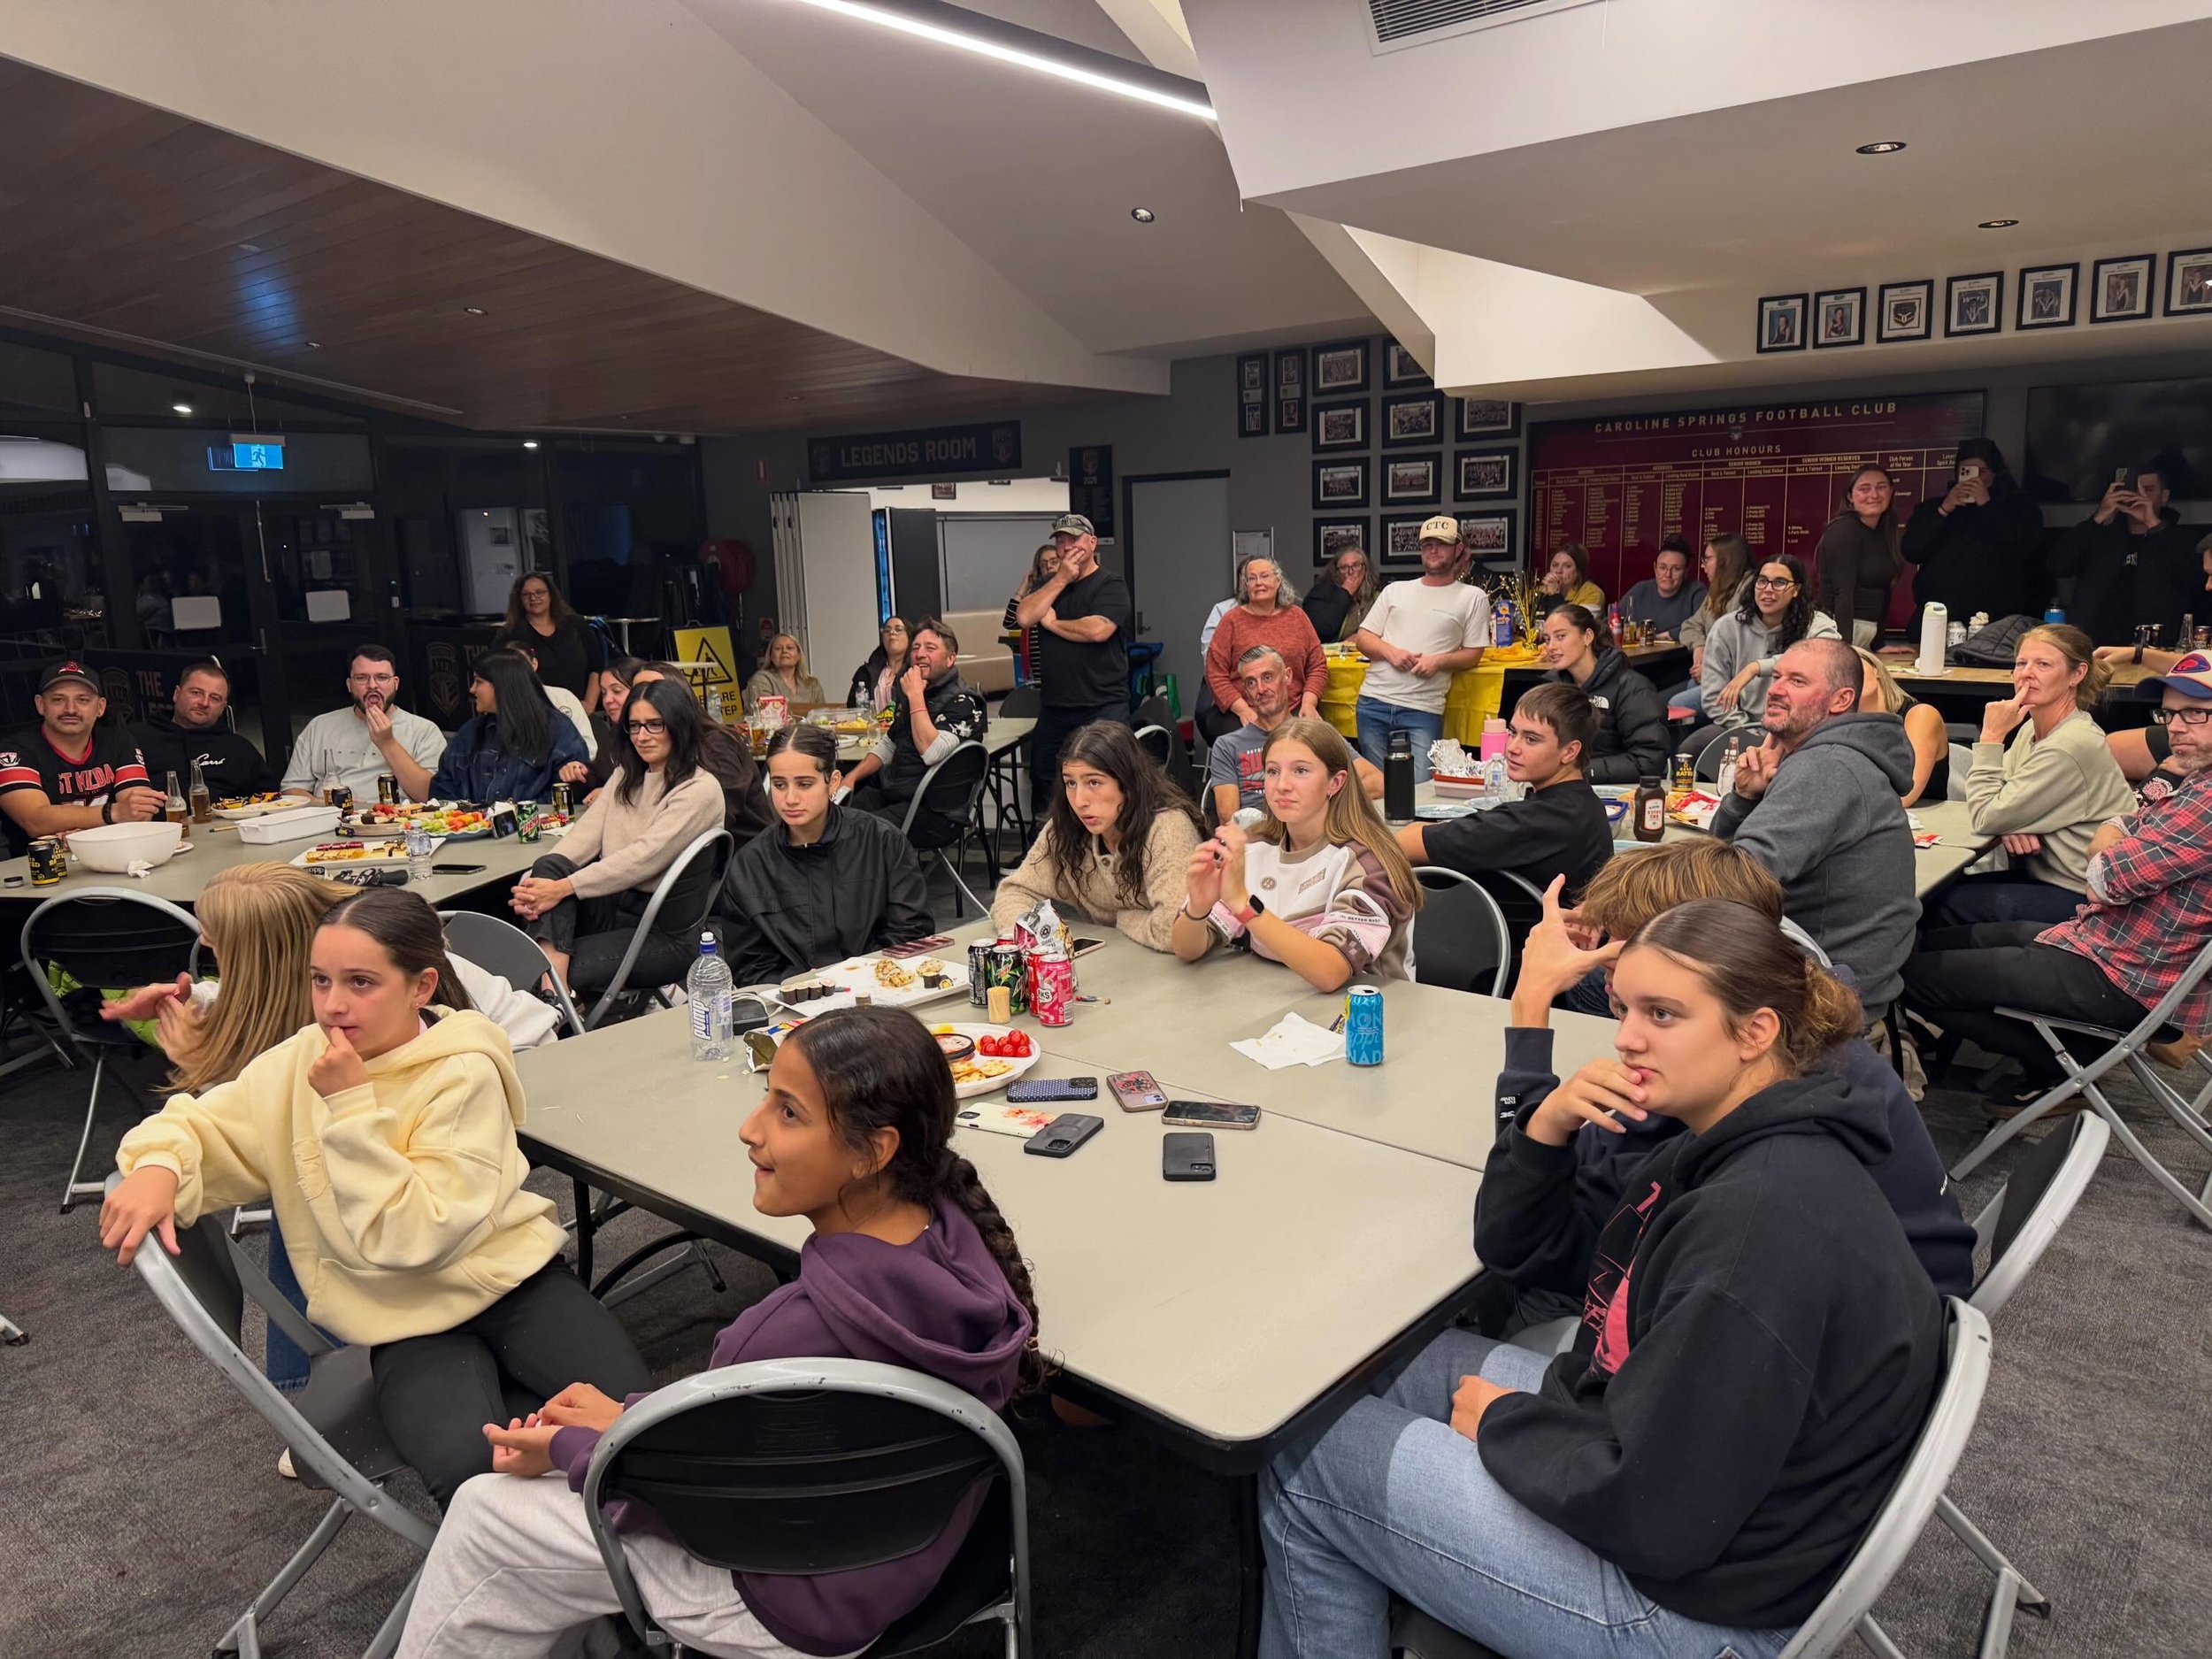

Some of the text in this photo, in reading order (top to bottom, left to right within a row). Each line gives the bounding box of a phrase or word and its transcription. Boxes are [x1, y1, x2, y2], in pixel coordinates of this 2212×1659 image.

[1594, 402, 1897, 433] CAROLINE SPRINGS FOOTBALL CLUB
[841, 437, 978, 468] LEGENDS ROOM
[1692, 444, 1781, 457] CLUB HONOURS
[1426, 520, 1448, 531] CTC
[135, 671, 164, 697] THE
[692, 999, 712, 1041] pump
